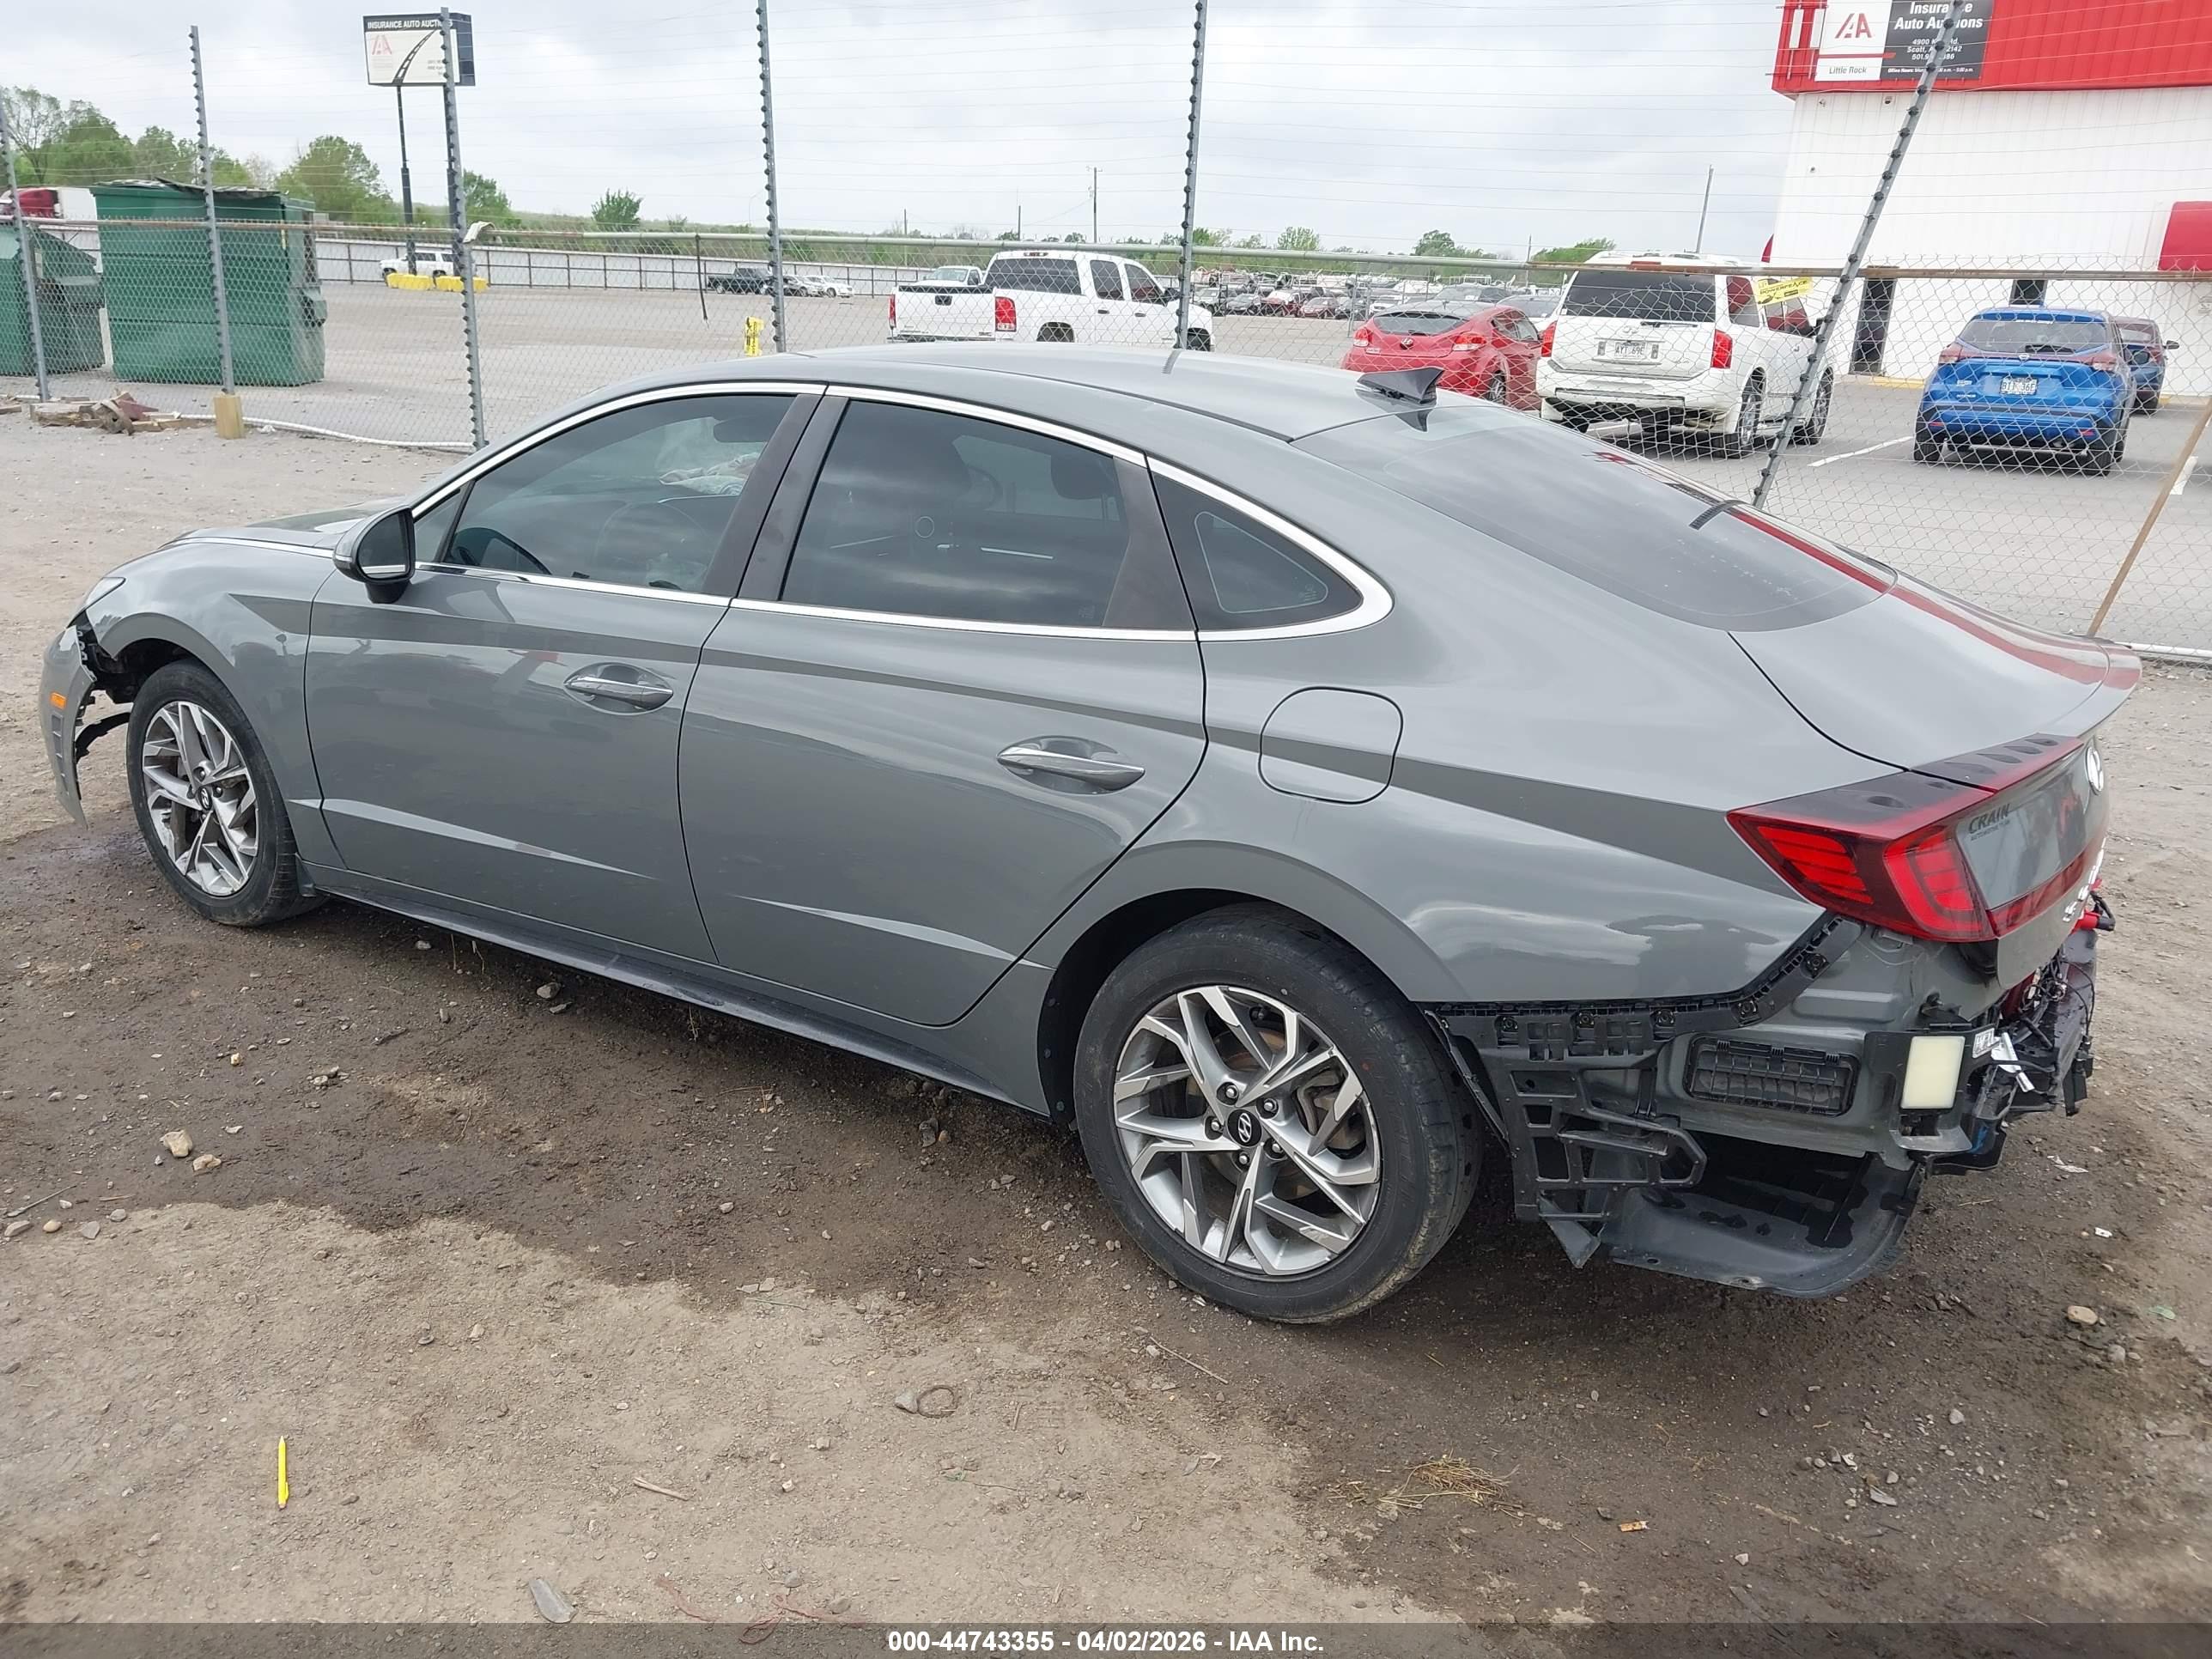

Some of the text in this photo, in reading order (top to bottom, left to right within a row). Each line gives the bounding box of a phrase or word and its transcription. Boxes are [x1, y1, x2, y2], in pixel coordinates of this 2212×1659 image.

[1910, 2, 1973, 15] Insurae
[368, 21, 403, 29] INSURANCE
[403, 20, 420, 28] AUTO
[1894, 17, 1923, 29] Auto
[1829, 65, 1867, 75] Little Rock
[1969, 804, 2010, 834] CRAIN
